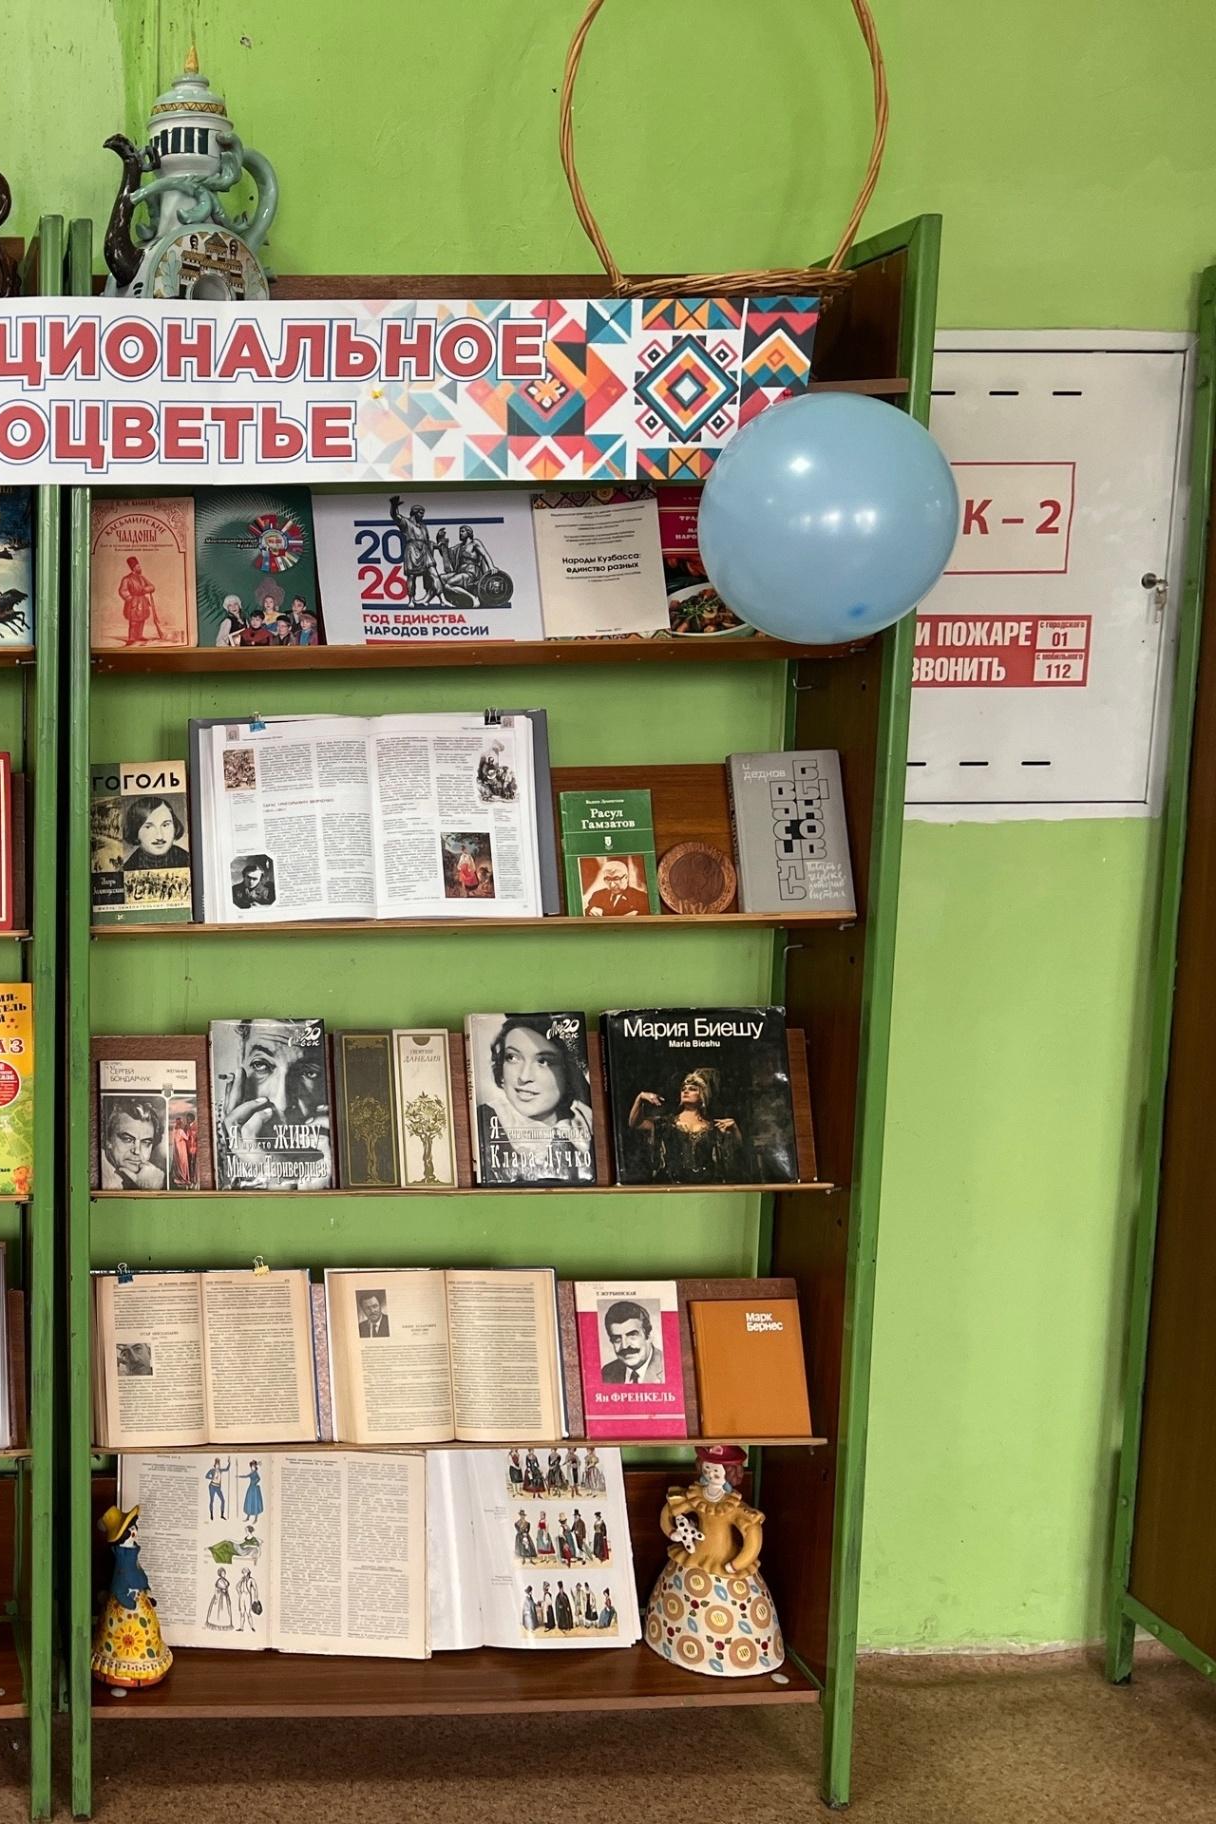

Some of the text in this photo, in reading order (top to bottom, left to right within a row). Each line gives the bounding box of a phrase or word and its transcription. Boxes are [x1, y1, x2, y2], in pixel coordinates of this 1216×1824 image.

[1035, 499, 1061, 535] 2
[354, 529, 406, 565] 20
[562, 556, 597, 566] Народы
[566, 561, 639, 574] единство разных
[357, 565, 409, 600] 26
[363, 614, 466, 625] ГОД ЕДИНСТВА
[364, 626, 490, 637] НАРОДОВ РОССИИ
[937, 621, 1033, 647] ПОЖАРЕ
[1052, 632, 1069, 648] 01
[1046, 663, 1072, 679] 112
[92, 772, 181, 792] ГОГОЛЬ
[590, 807, 624, 819] Расул
[580, 818, 636, 830] Гамзатов
[300, 1027, 321, 1040] 20
[623, 1018, 764, 1040] Мария Биешу
[668, 1040, 721, 1048] Maria Bieshu
[228, 1124, 239, 1150] Я
[272, 1123, 321, 1150] ЖИВУ
[490, 1144, 592, 1176] Клара Лучко
[745, 1312, 773, 1324] Марк
[746, 1322, 784, 1332] Бернес
[594, 1391, 677, 1403] Ян ФРЕНКЕЛЬ
